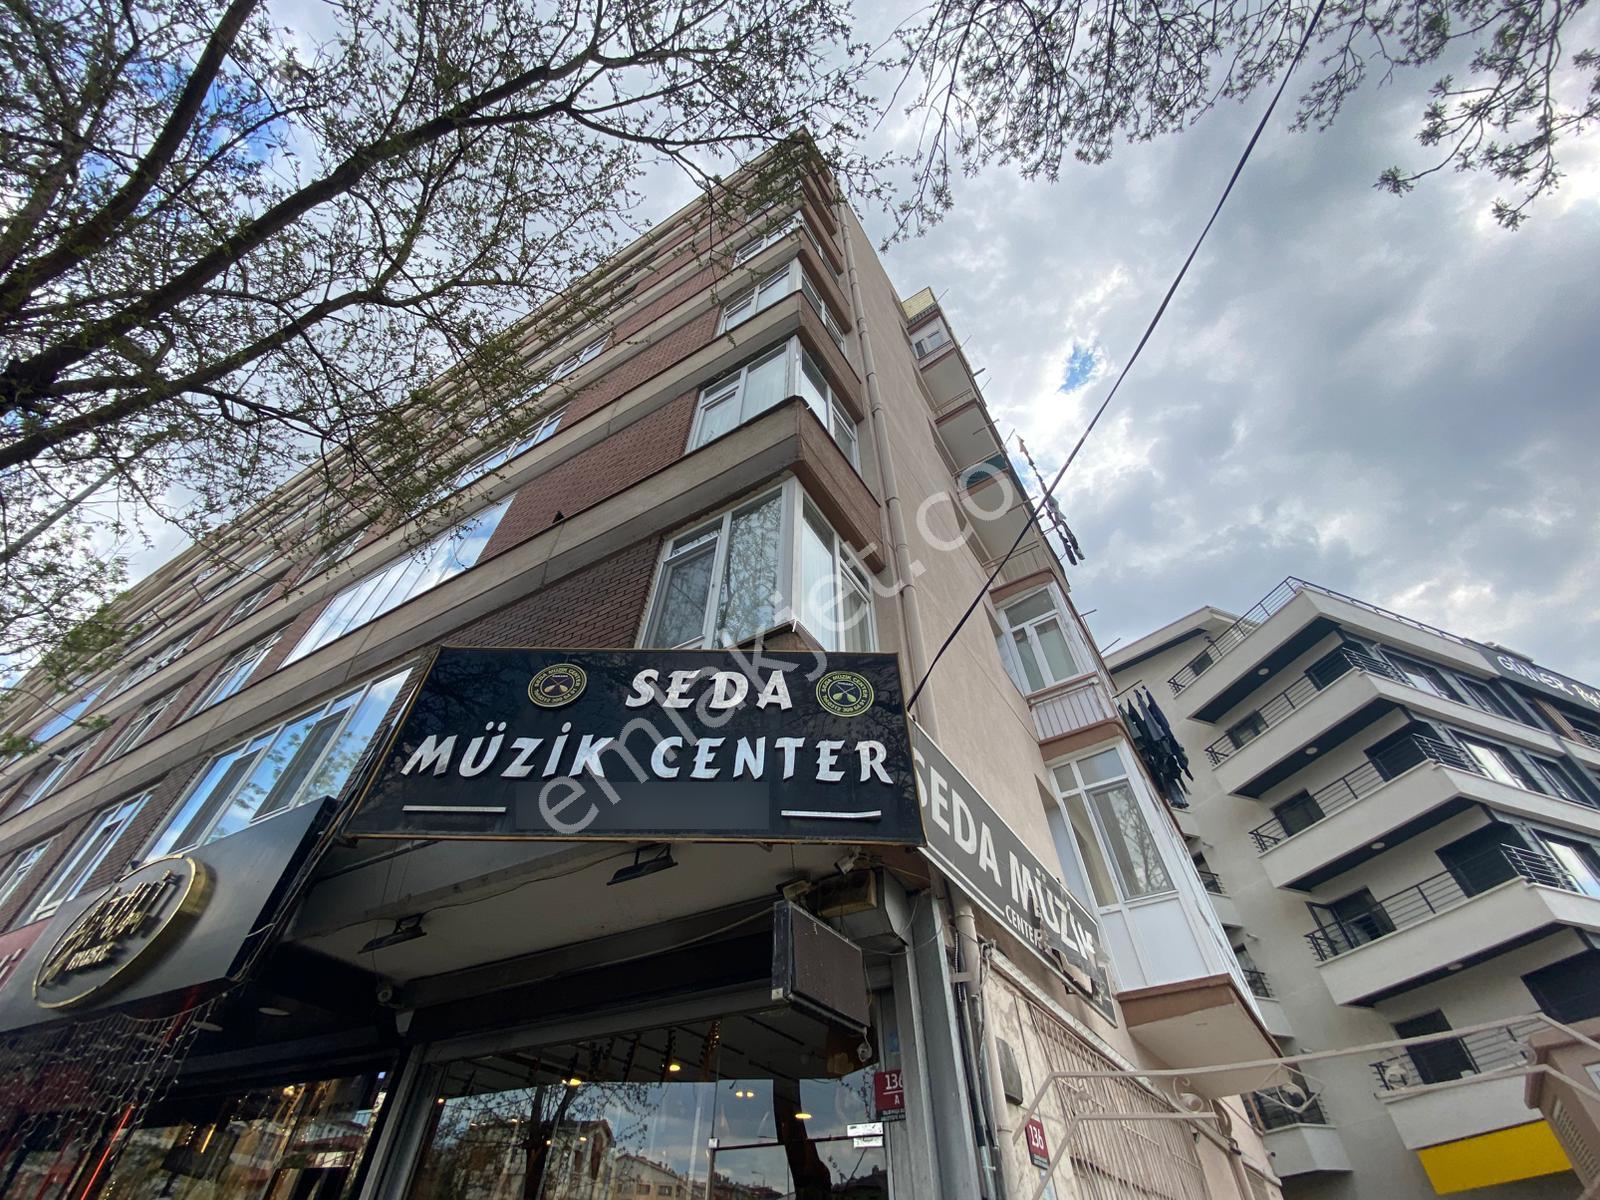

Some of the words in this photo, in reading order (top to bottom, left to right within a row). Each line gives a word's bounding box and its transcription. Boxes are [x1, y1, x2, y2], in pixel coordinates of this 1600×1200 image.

[625, 669, 793, 711] SEDA
[401, 721, 613, 779] MÜZİK
[650, 735, 894, 785] CENTER
[1005, 904, 1043, 947] CENTER
[1009, 850, 1096, 961] MÜZİK
[1028, 1124, 1045, 1150] 136
